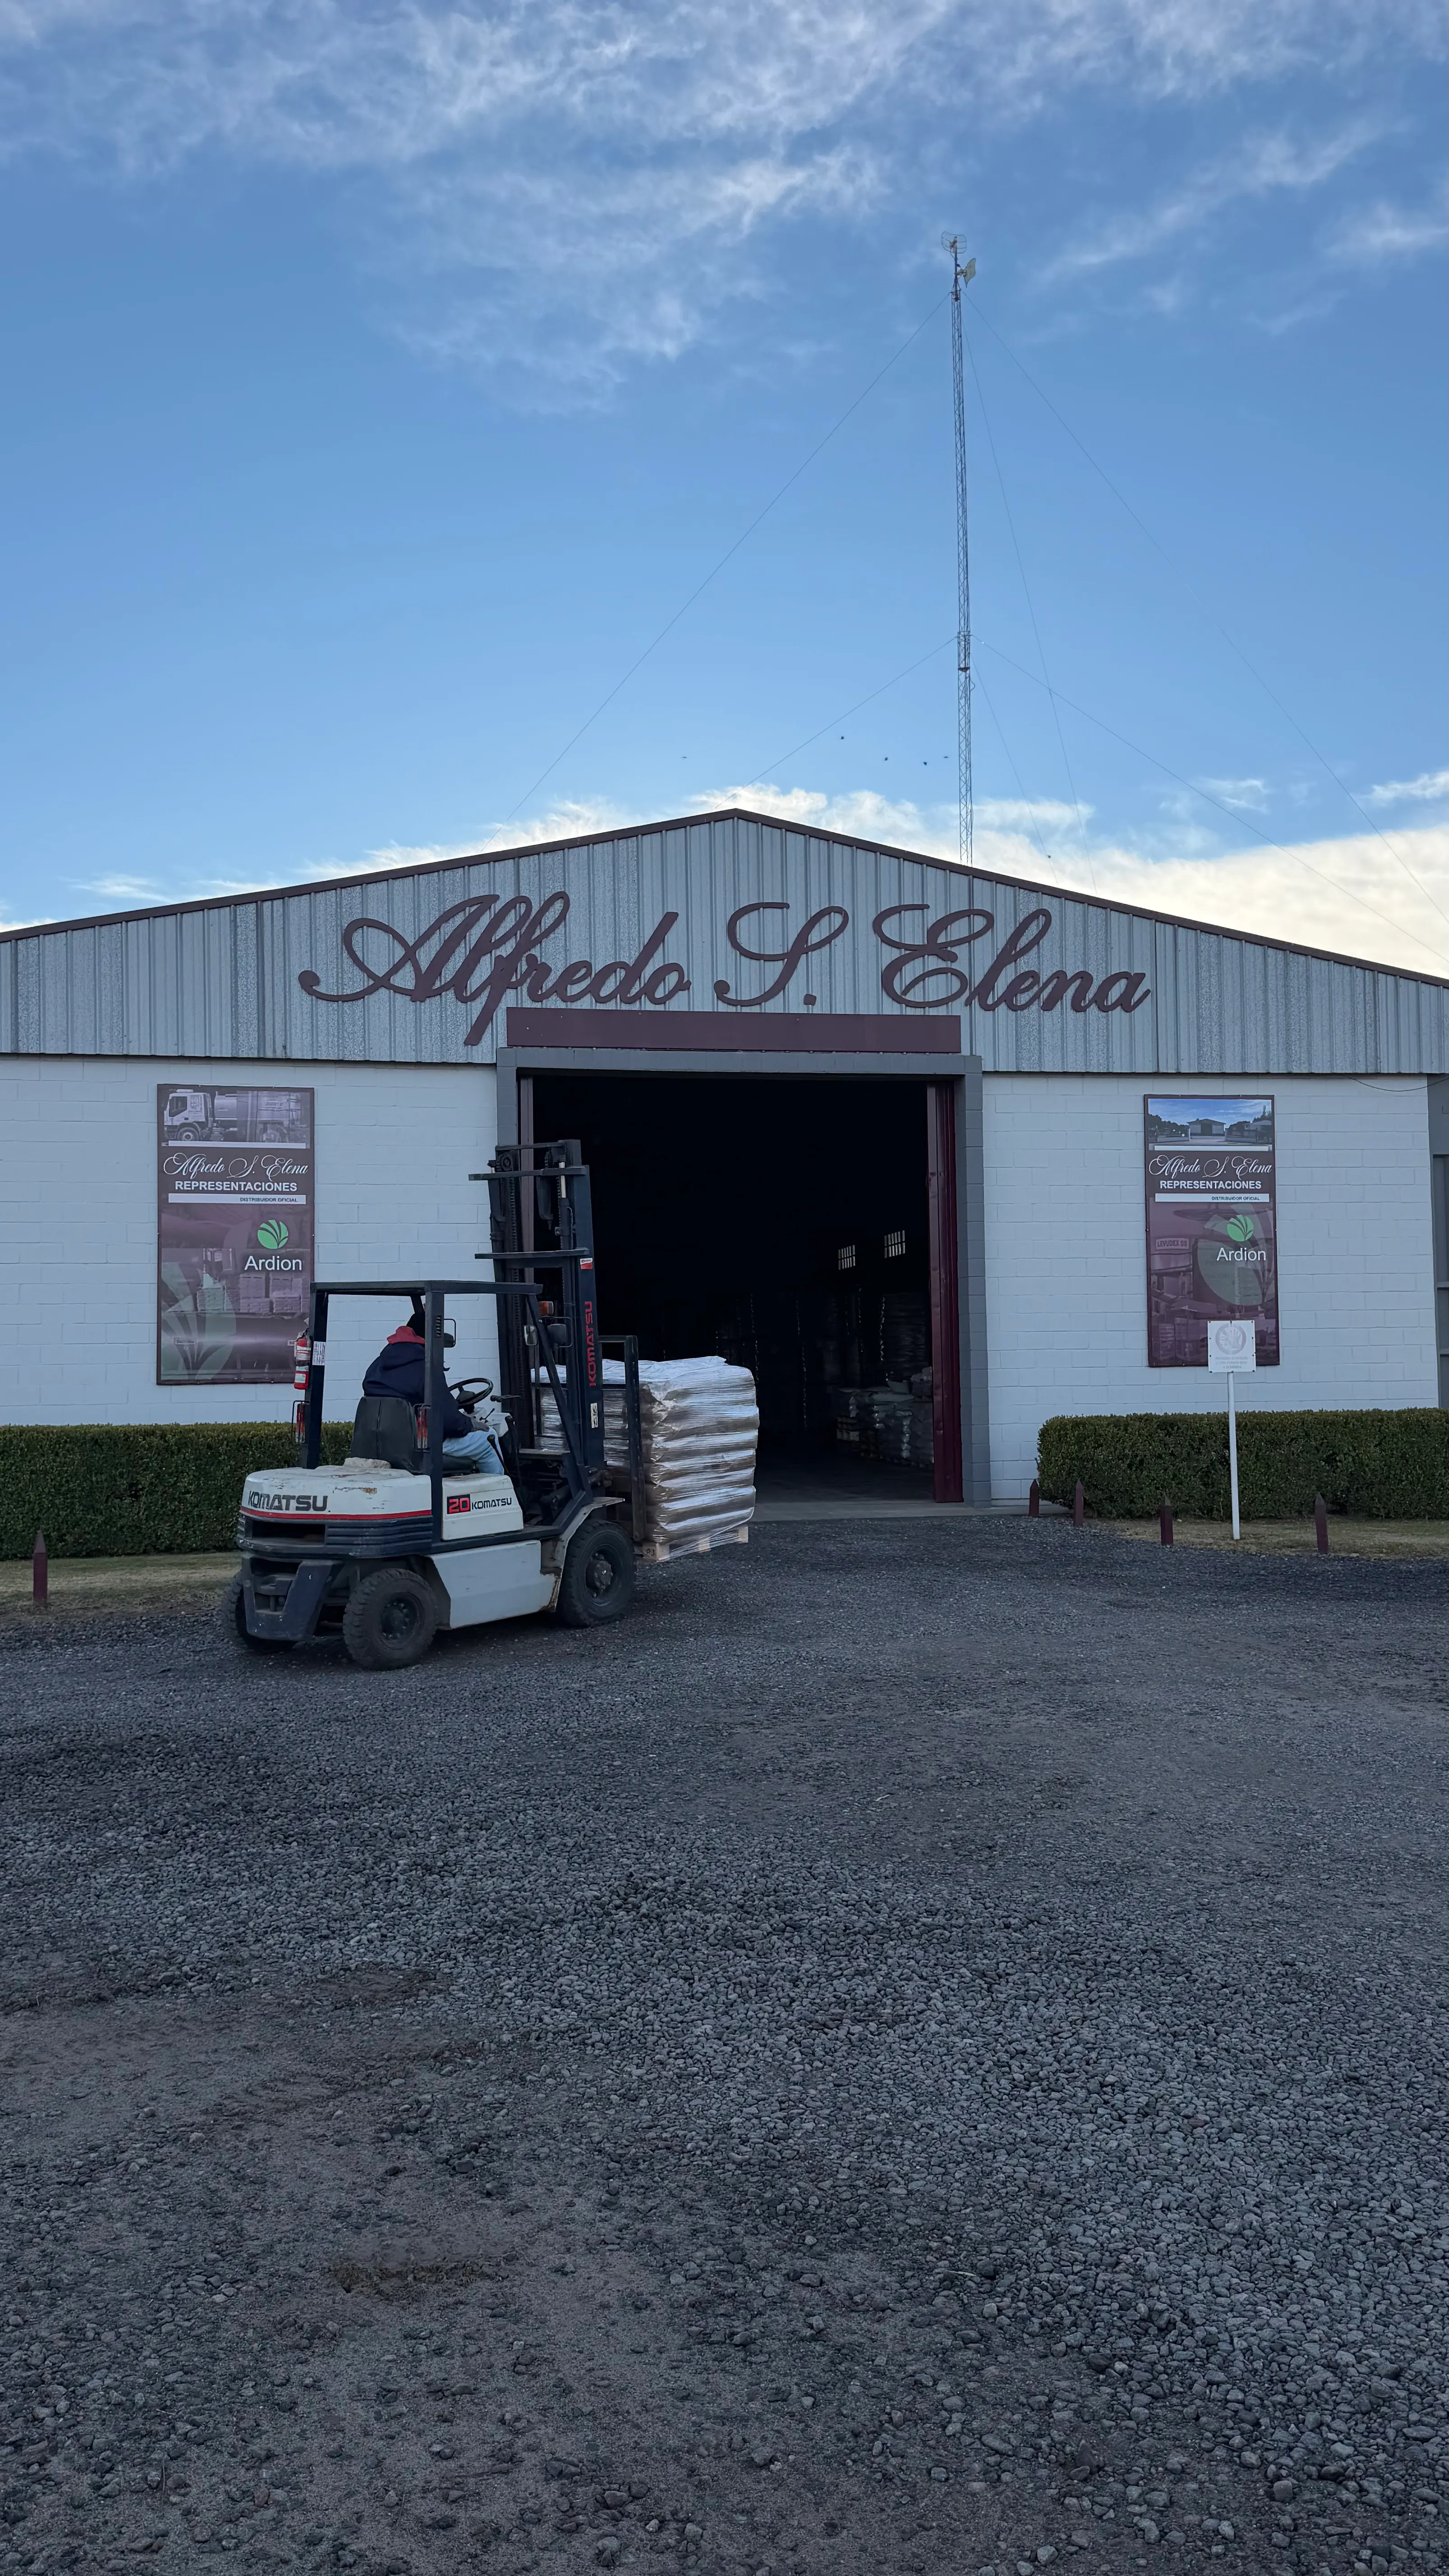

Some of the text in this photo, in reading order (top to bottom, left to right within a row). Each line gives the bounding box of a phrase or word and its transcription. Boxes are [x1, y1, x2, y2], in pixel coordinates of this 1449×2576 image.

[299, 891, 1150, 1046] Alfredo S. Elena
[164, 1153, 308, 1182] Alfredo S. Elena
[1149, 1155, 1272, 1180] Alfredo S. Elena
[175, 1181, 298, 1191] REPRESENTACIONES
[1160, 1180, 1262, 1189] REPRESENTACIONES
[244, 1256, 302, 1270] Ardion
[1217, 1247, 1266, 1261] Ardion
[584, 1301, 596, 1387] KOMATSU
[248, 1490, 328, 1511] KOMATSU
[449, 1497, 512, 1513] 20 KOMATSU
